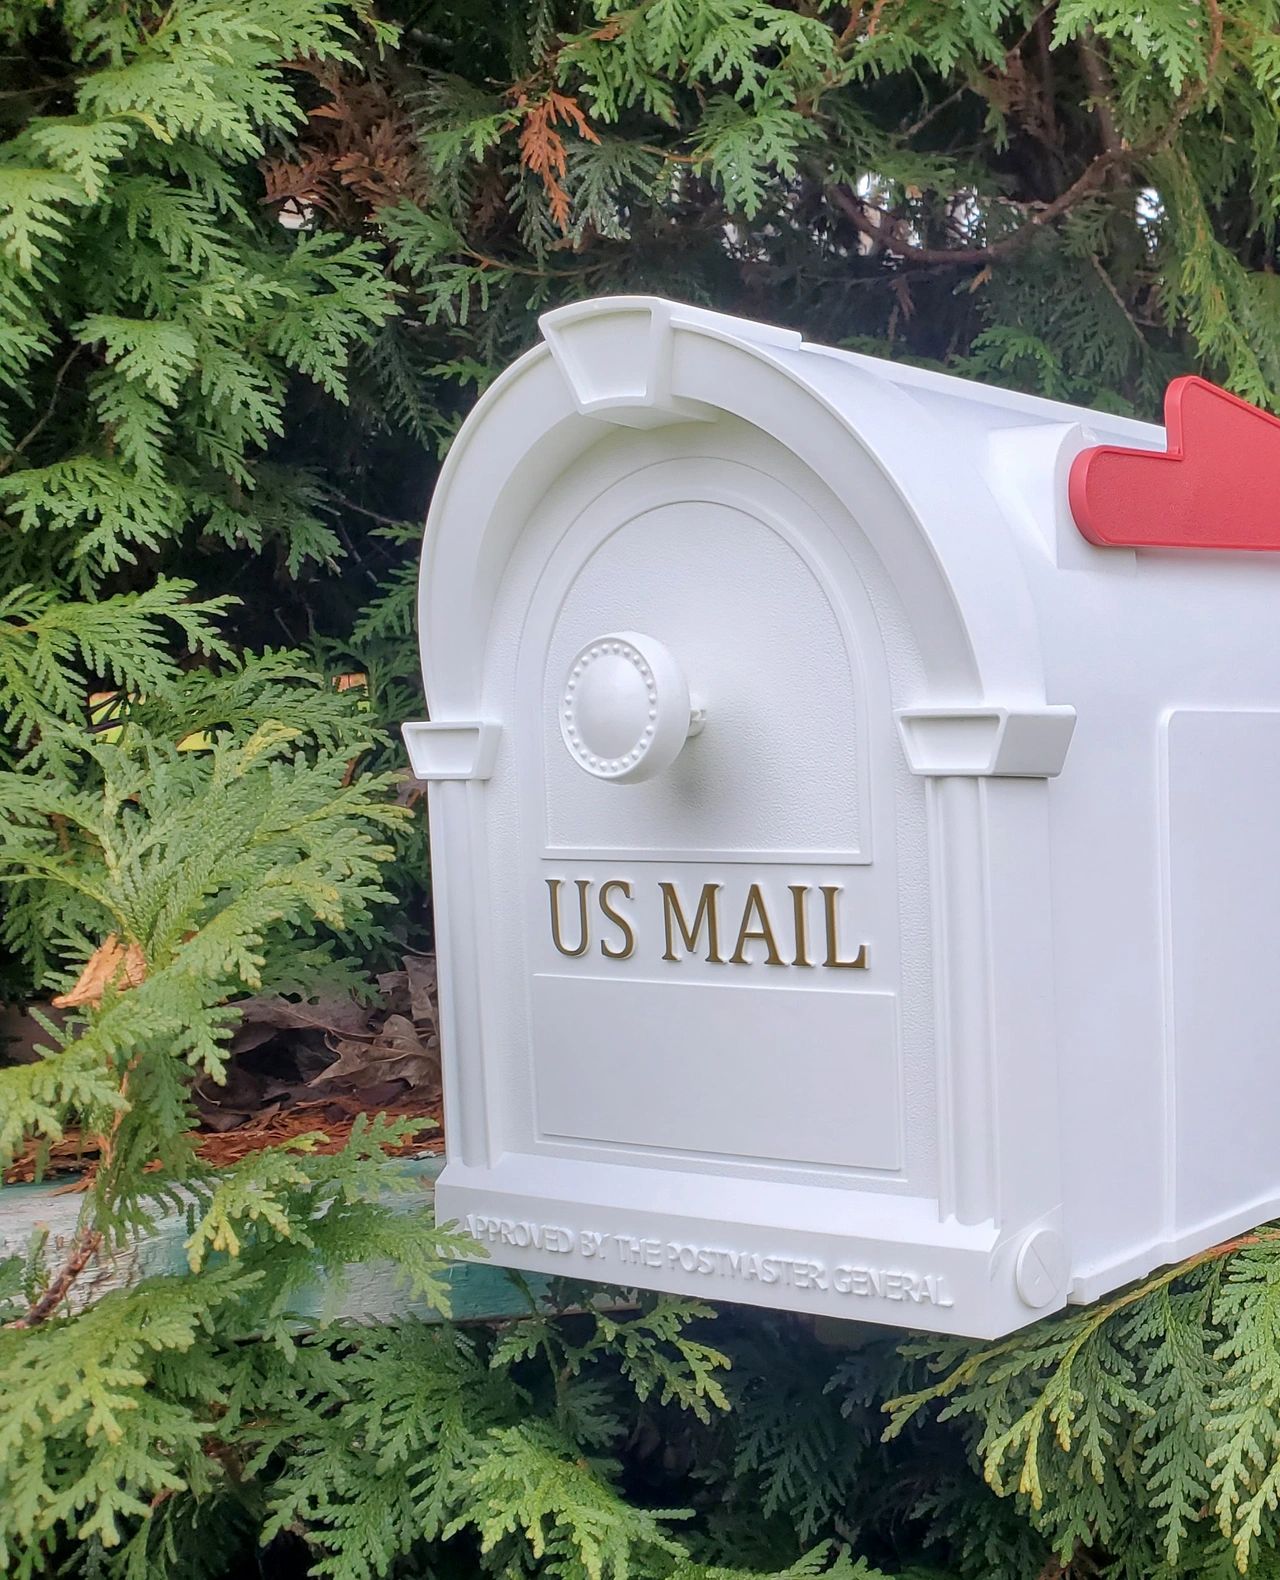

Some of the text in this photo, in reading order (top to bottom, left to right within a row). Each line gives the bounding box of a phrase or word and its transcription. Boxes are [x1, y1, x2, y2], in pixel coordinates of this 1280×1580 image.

[544, 878, 872, 970] US MAIL
[464, 1213, 954, 1308] APPROVED BY THE POSTMASTER GENERAL
